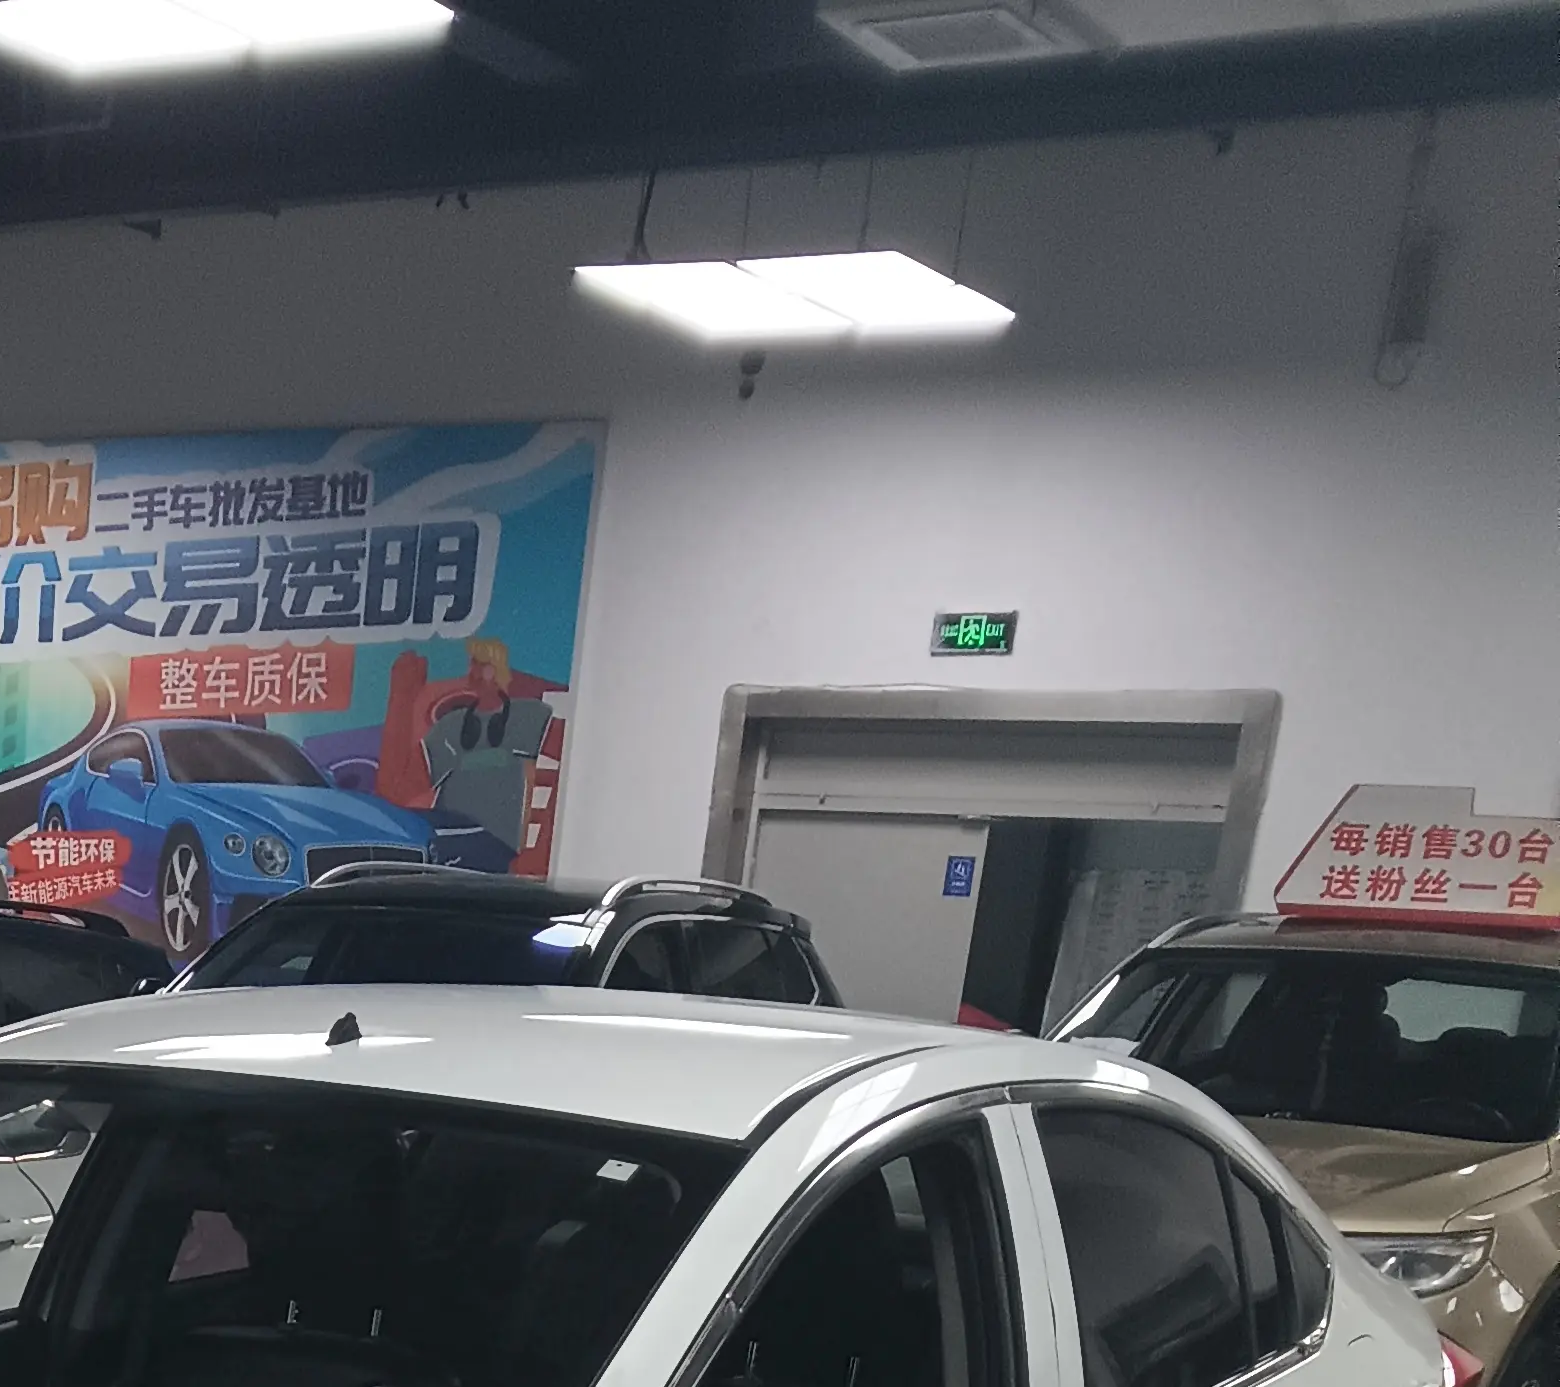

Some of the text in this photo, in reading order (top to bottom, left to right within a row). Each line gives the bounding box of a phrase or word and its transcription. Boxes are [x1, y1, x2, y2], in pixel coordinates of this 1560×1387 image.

[95, 469, 369, 534] 二手车批发基地
[159, 650, 329, 712] 整车质保
[31, 837, 116, 868] 节能环保
[1330, 821, 1555, 864] 每销售30台
[1319, 864, 1544, 909] 送粉丝一台
